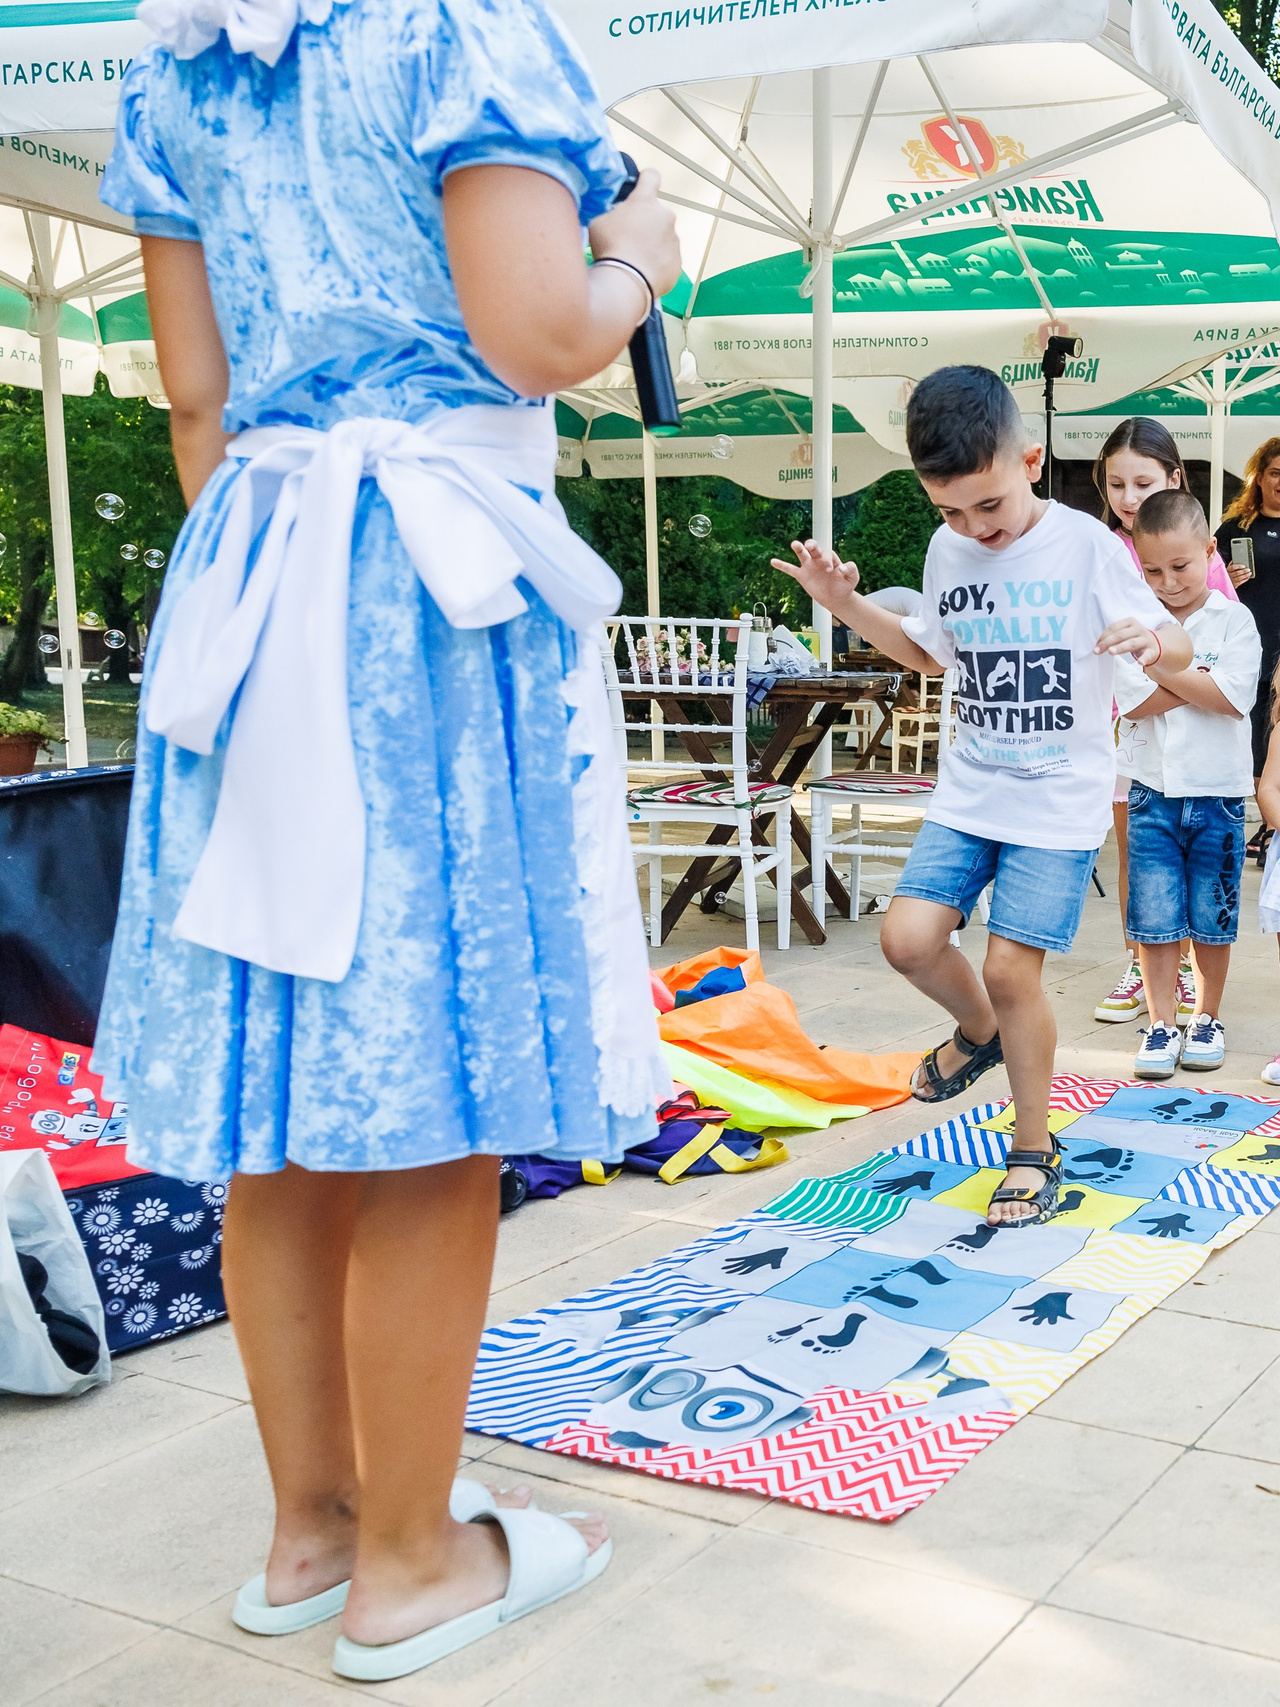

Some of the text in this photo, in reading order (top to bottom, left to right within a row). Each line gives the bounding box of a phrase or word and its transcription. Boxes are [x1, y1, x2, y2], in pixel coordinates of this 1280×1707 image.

[608, 0, 798, 38] С ОТЛИЧИТЕЛЕН
[1162, 0, 1211, 66] РВАТА
[1210, 49, 1276, 133] БЪЛГАРСКА
[939, 579, 1073, 618] BOY, YOU
[957, 700, 1074, 734] GOT THIS
